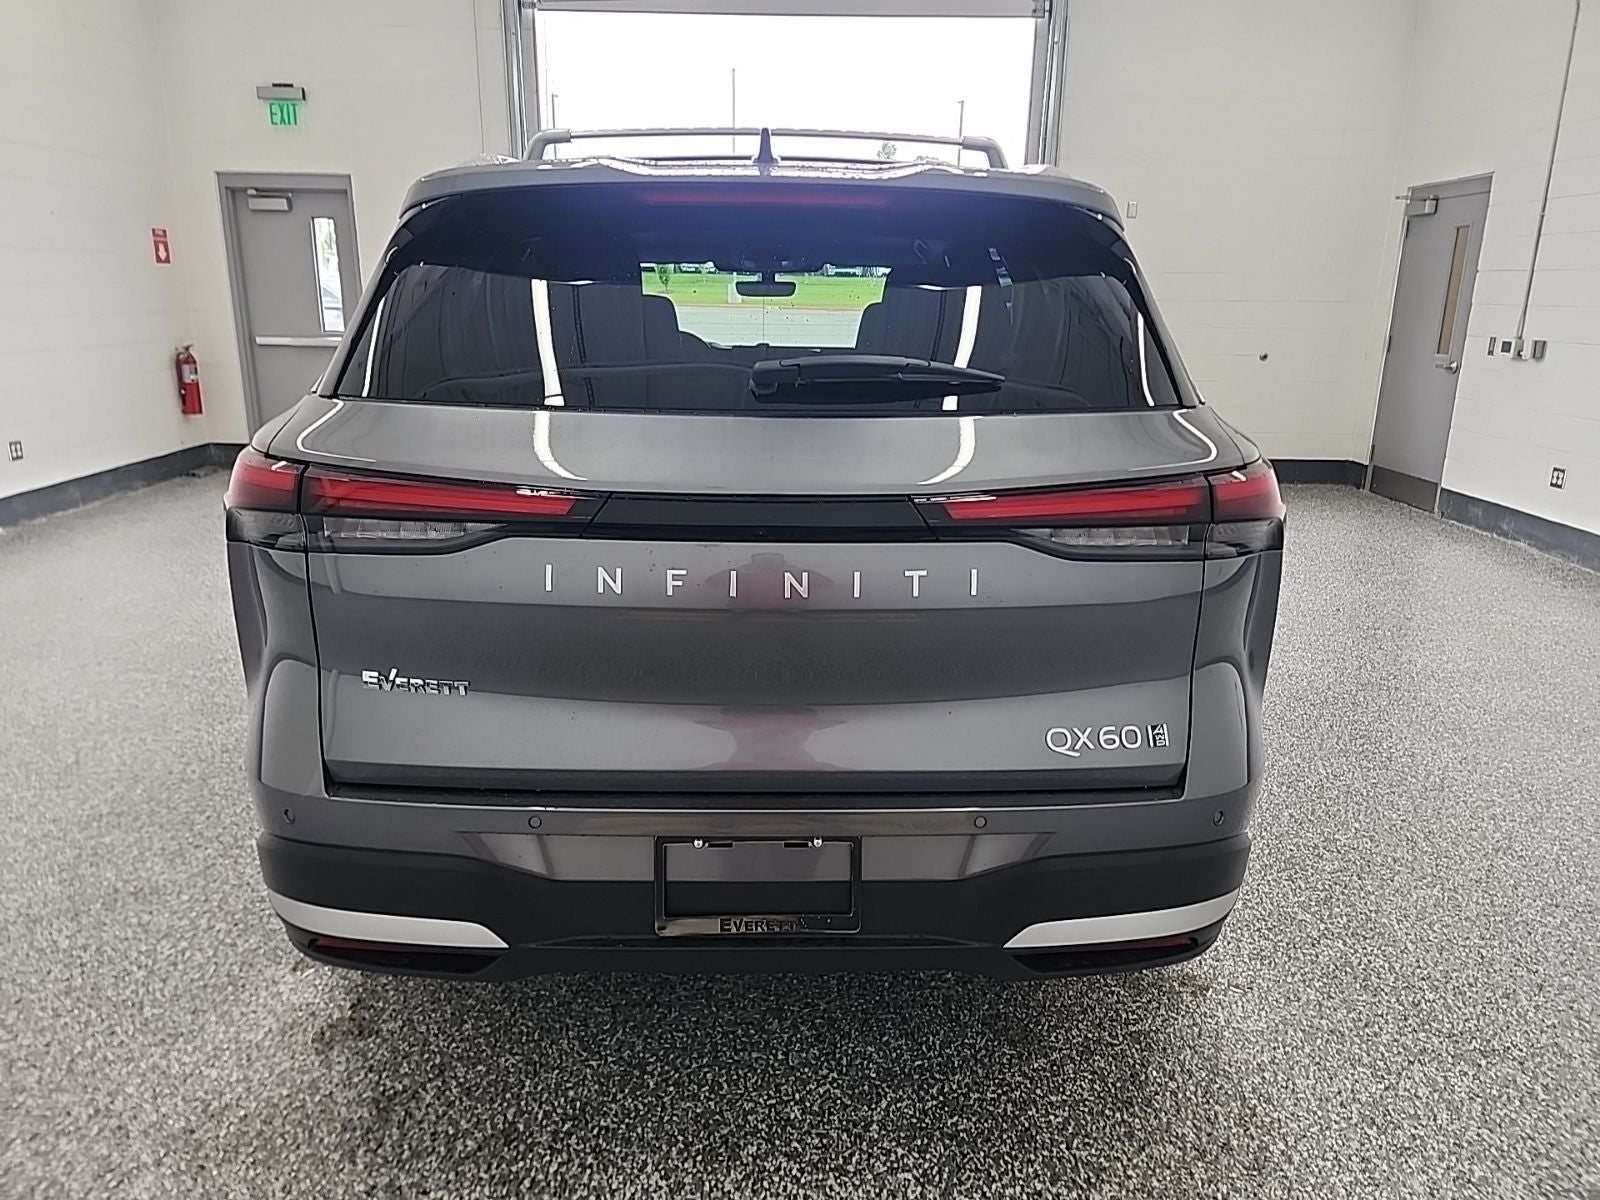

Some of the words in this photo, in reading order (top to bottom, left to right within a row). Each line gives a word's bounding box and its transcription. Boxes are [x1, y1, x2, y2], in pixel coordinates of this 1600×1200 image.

[269, 103, 298, 125] EXIT
[544, 563, 978, 599] INFINITI
[361, 667, 470, 696] EVERETT
[1044, 725, 1142, 757] QX60
